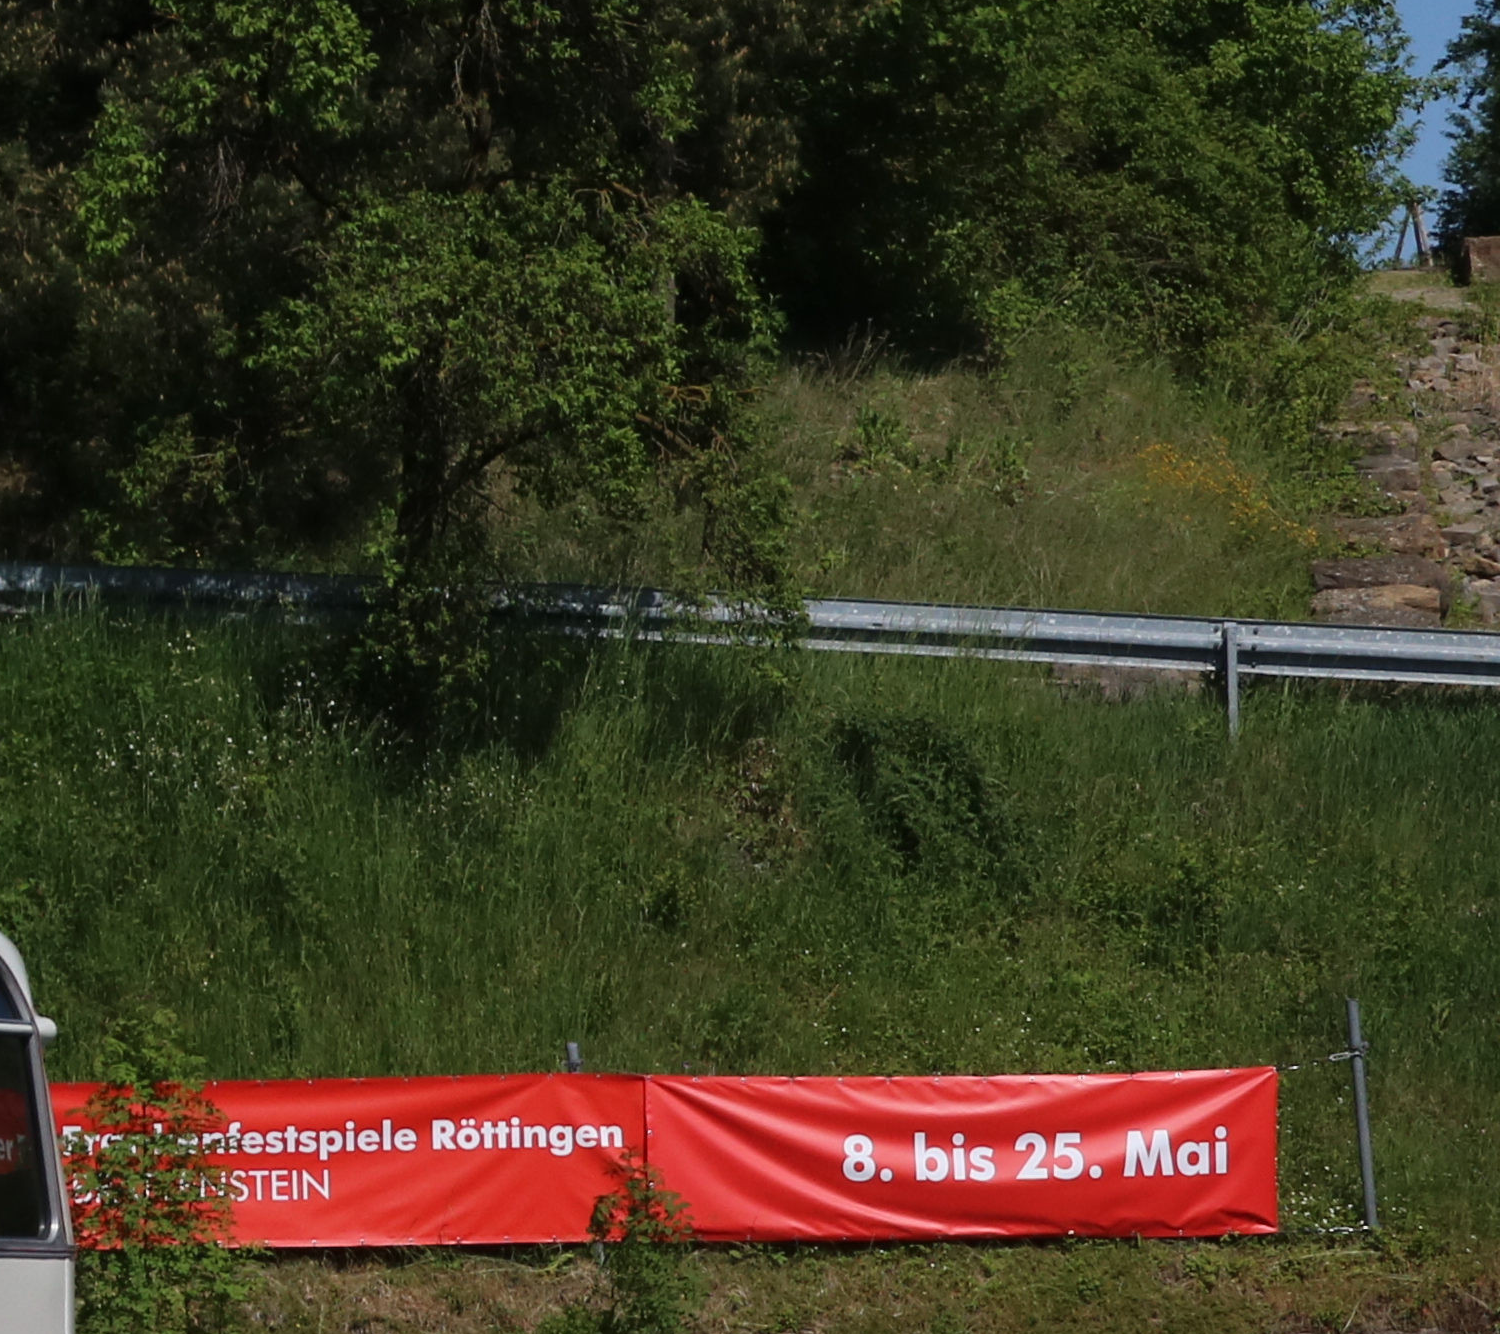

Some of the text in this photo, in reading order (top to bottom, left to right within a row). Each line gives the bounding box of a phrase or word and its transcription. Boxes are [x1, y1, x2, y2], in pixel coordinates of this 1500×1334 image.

[431, 1116, 623, 1156] Röttingen
[842, 1124, 1229, 1182] 8. bis 25. Mai
